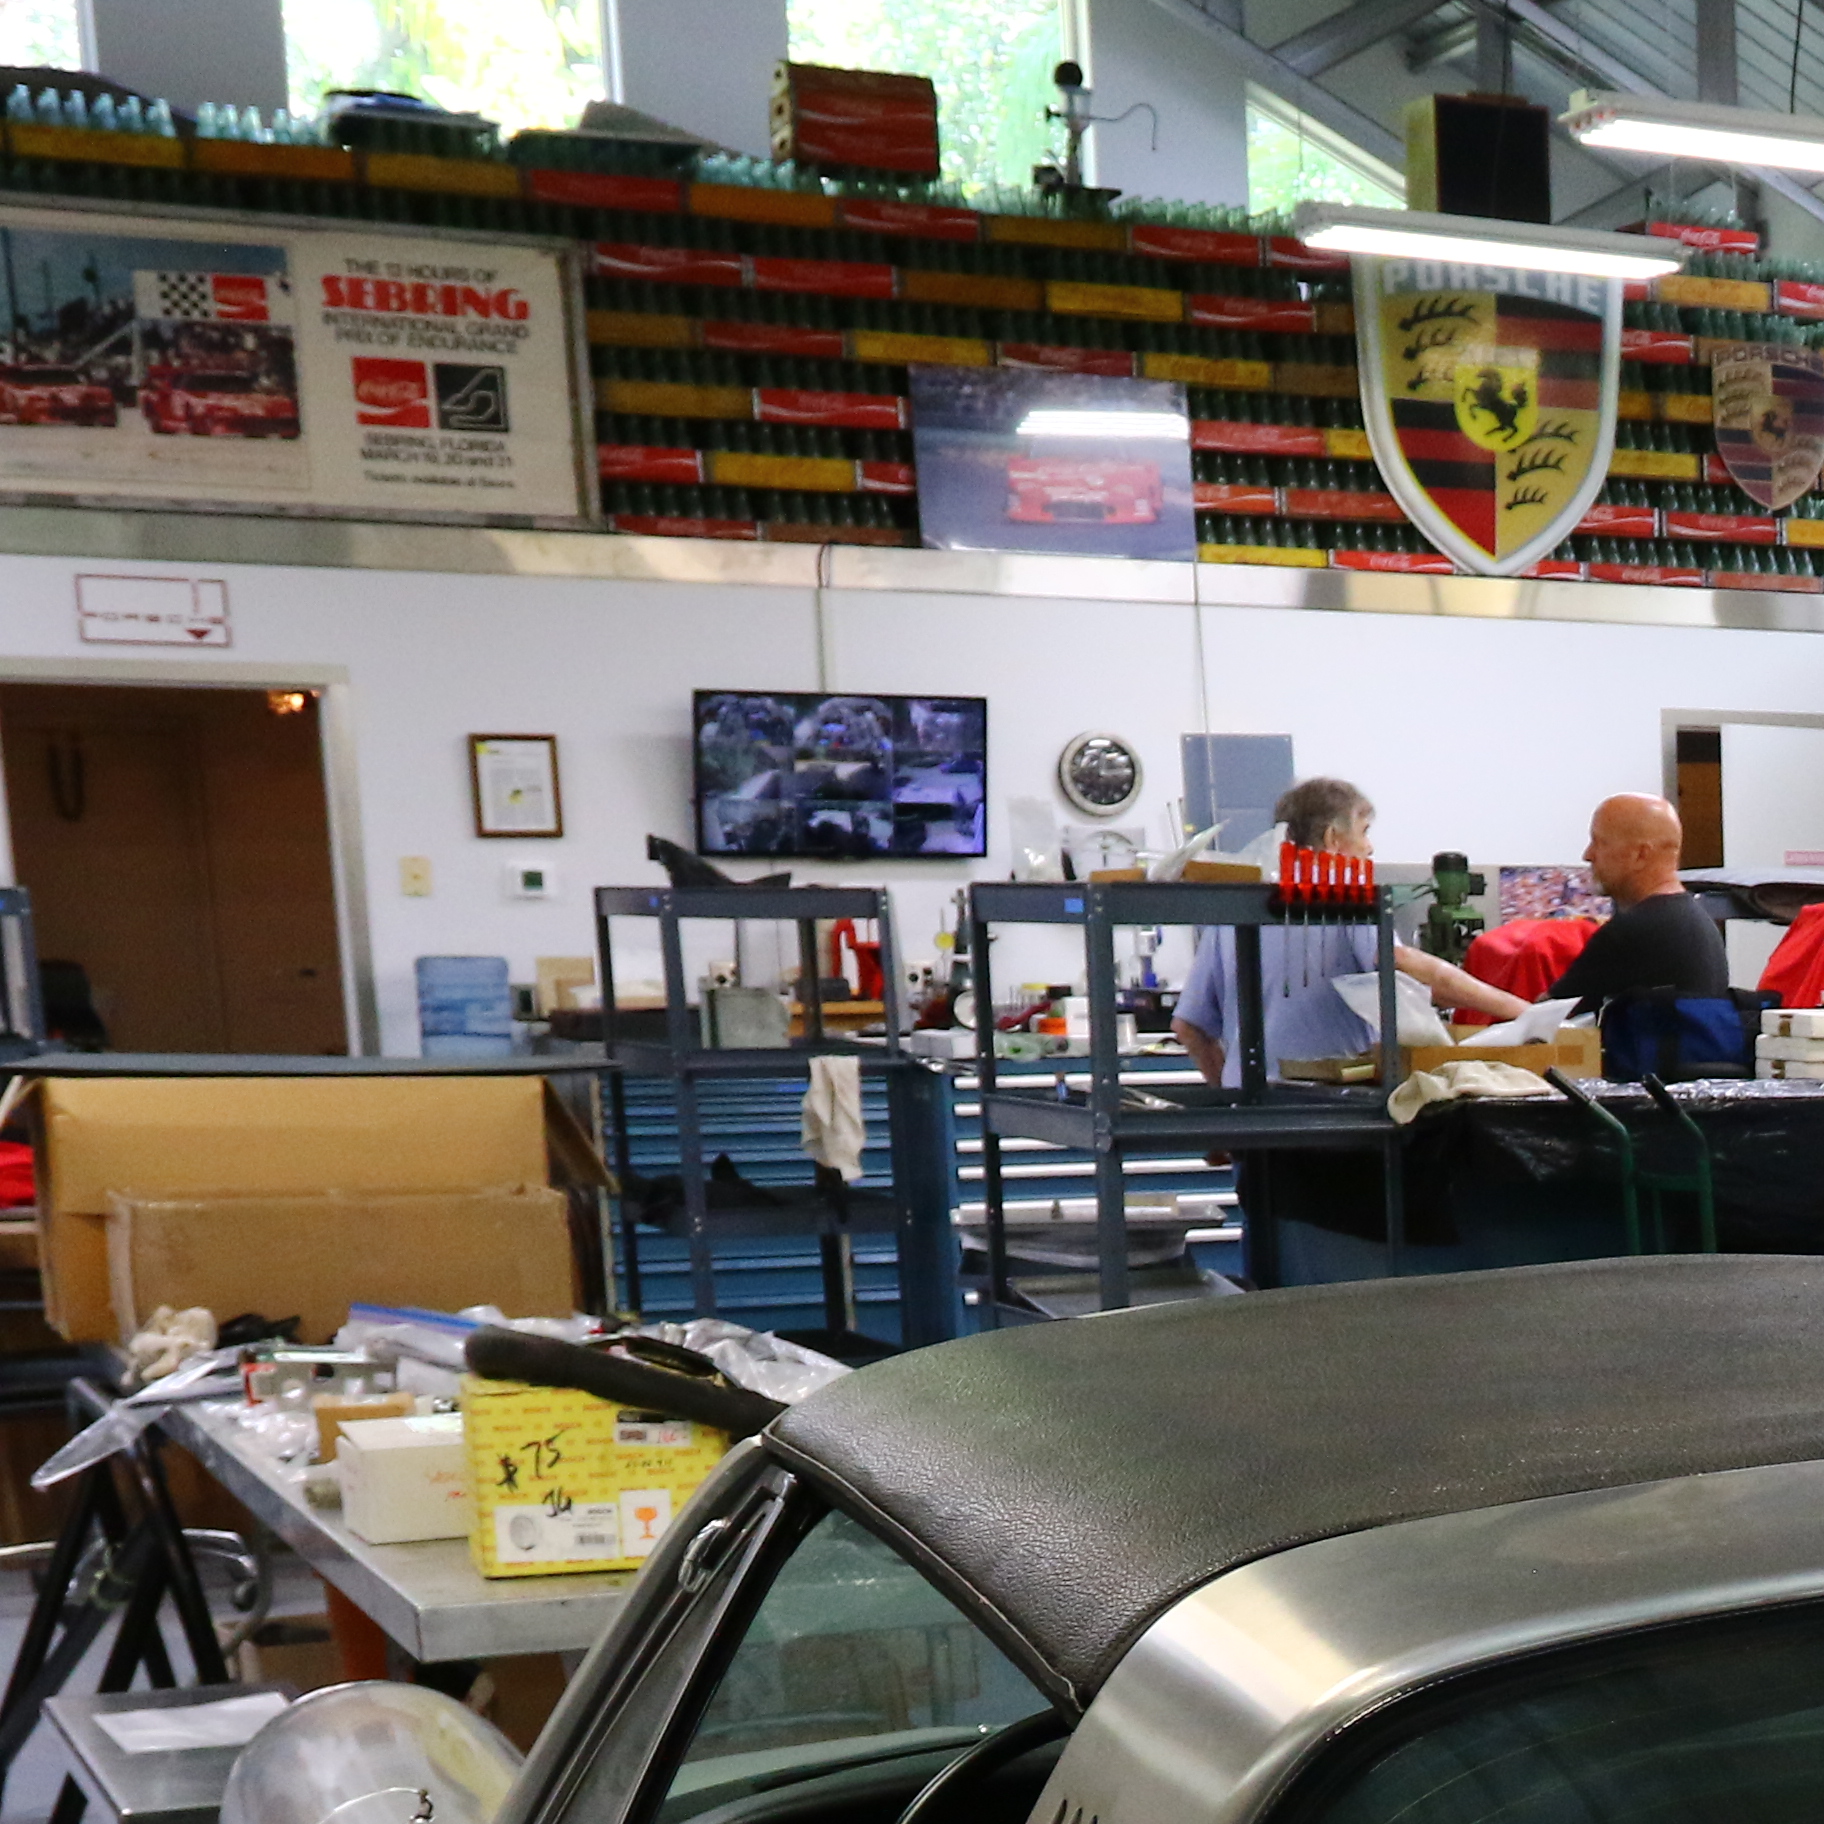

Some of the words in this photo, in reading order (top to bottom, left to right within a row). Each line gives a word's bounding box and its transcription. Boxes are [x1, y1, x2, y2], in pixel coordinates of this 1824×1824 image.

[345, 258, 379, 275] THE
[406, 264, 470, 281] HOURS
[473, 267, 498, 283] OF
[321, 273, 530, 320] SEBRING
[1384, 260, 1602, 312] PORSCHE
[322, 310, 457, 334] INTERNATIONAL
[465, 320, 530, 340] GRAND
[376, 330, 400, 346] OF
[406, 331, 520, 354] ENDURANCE
